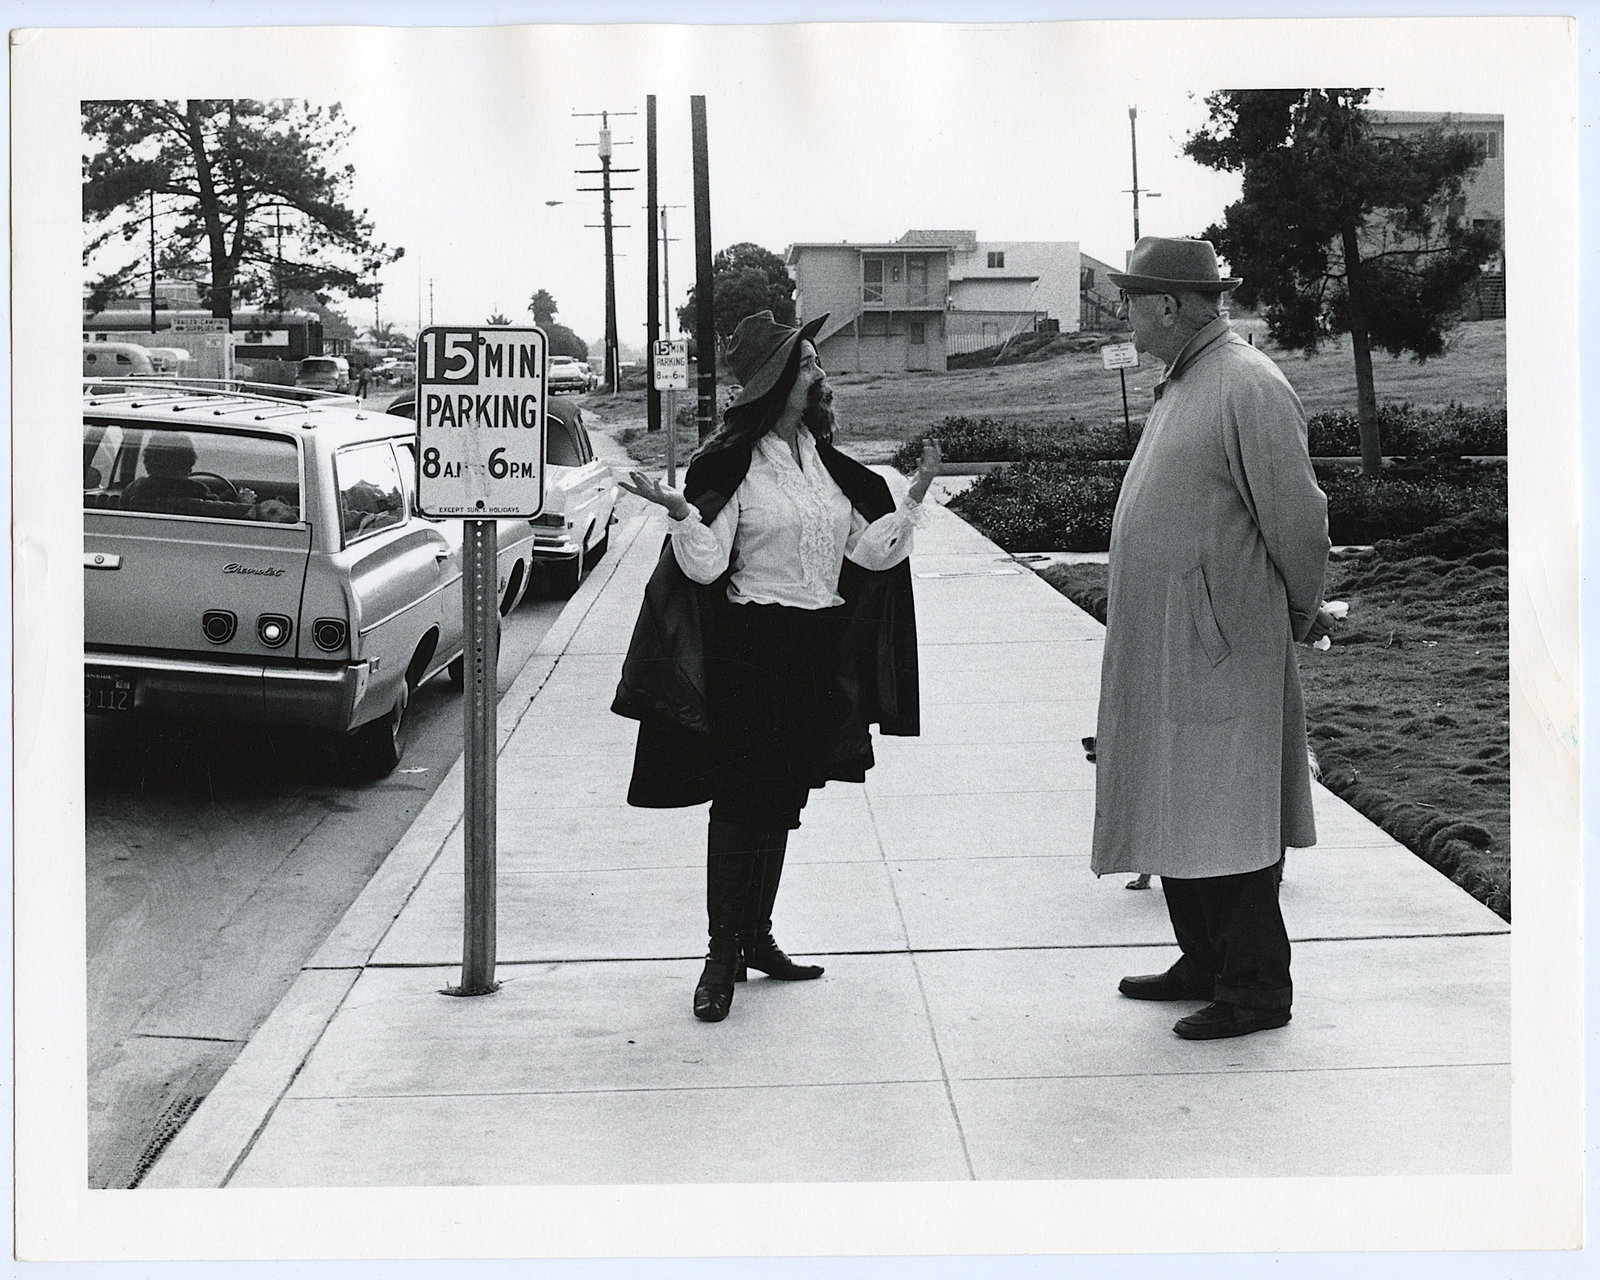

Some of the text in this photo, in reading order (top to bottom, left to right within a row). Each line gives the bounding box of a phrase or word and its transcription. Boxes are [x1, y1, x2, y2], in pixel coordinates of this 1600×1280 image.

[423, 332, 540, 380] 15 MIN.
[655, 342, 669, 355] 15
[656, 358, 685, 367] PARKING
[426, 394, 537, 429] PARKING
[488, 447, 509, 479] 6
[222, 561, 286, 578] Chevrolet
